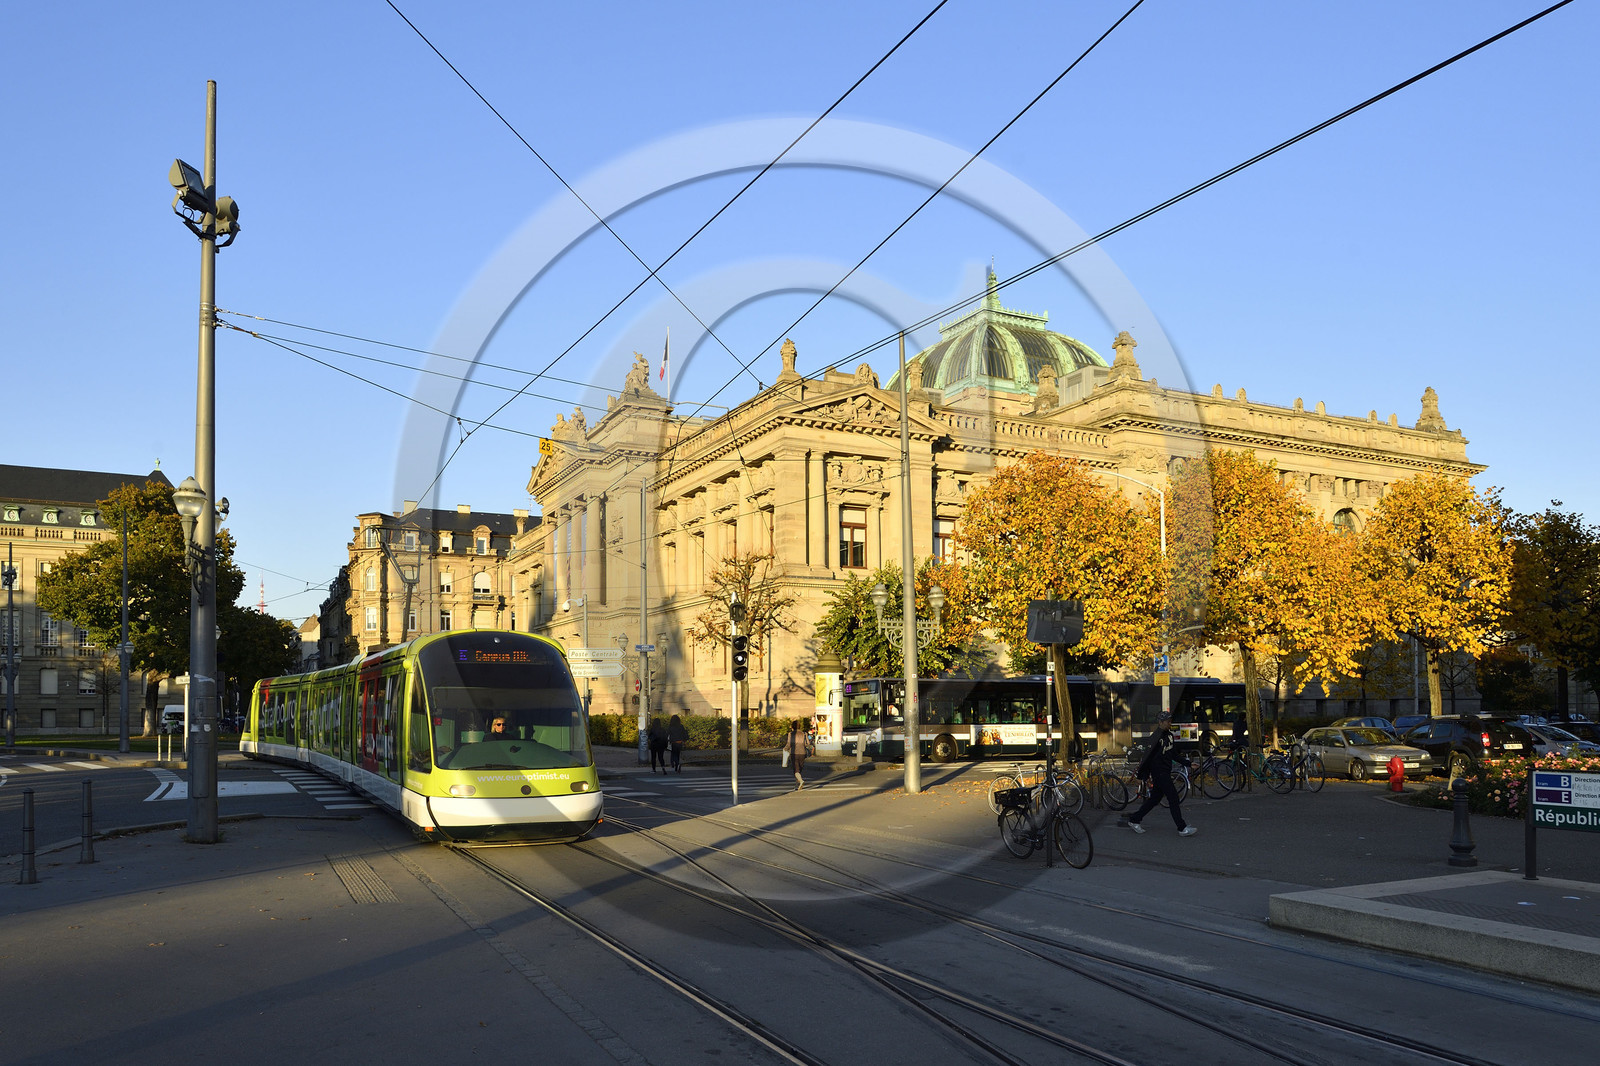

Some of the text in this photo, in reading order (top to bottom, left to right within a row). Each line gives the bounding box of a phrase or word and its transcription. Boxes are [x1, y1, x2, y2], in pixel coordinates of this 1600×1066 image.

[541, 441, 551, 451] 25
[475, 650, 510, 662] Campus
[261, 694, 297, 729] Strabourg
[477, 772, 570, 782] www.europtimist.eu
[1560, 776, 1570, 788] B
[1561, 791, 1570, 803] E
[1535, 808, 1600, 826] Républi
